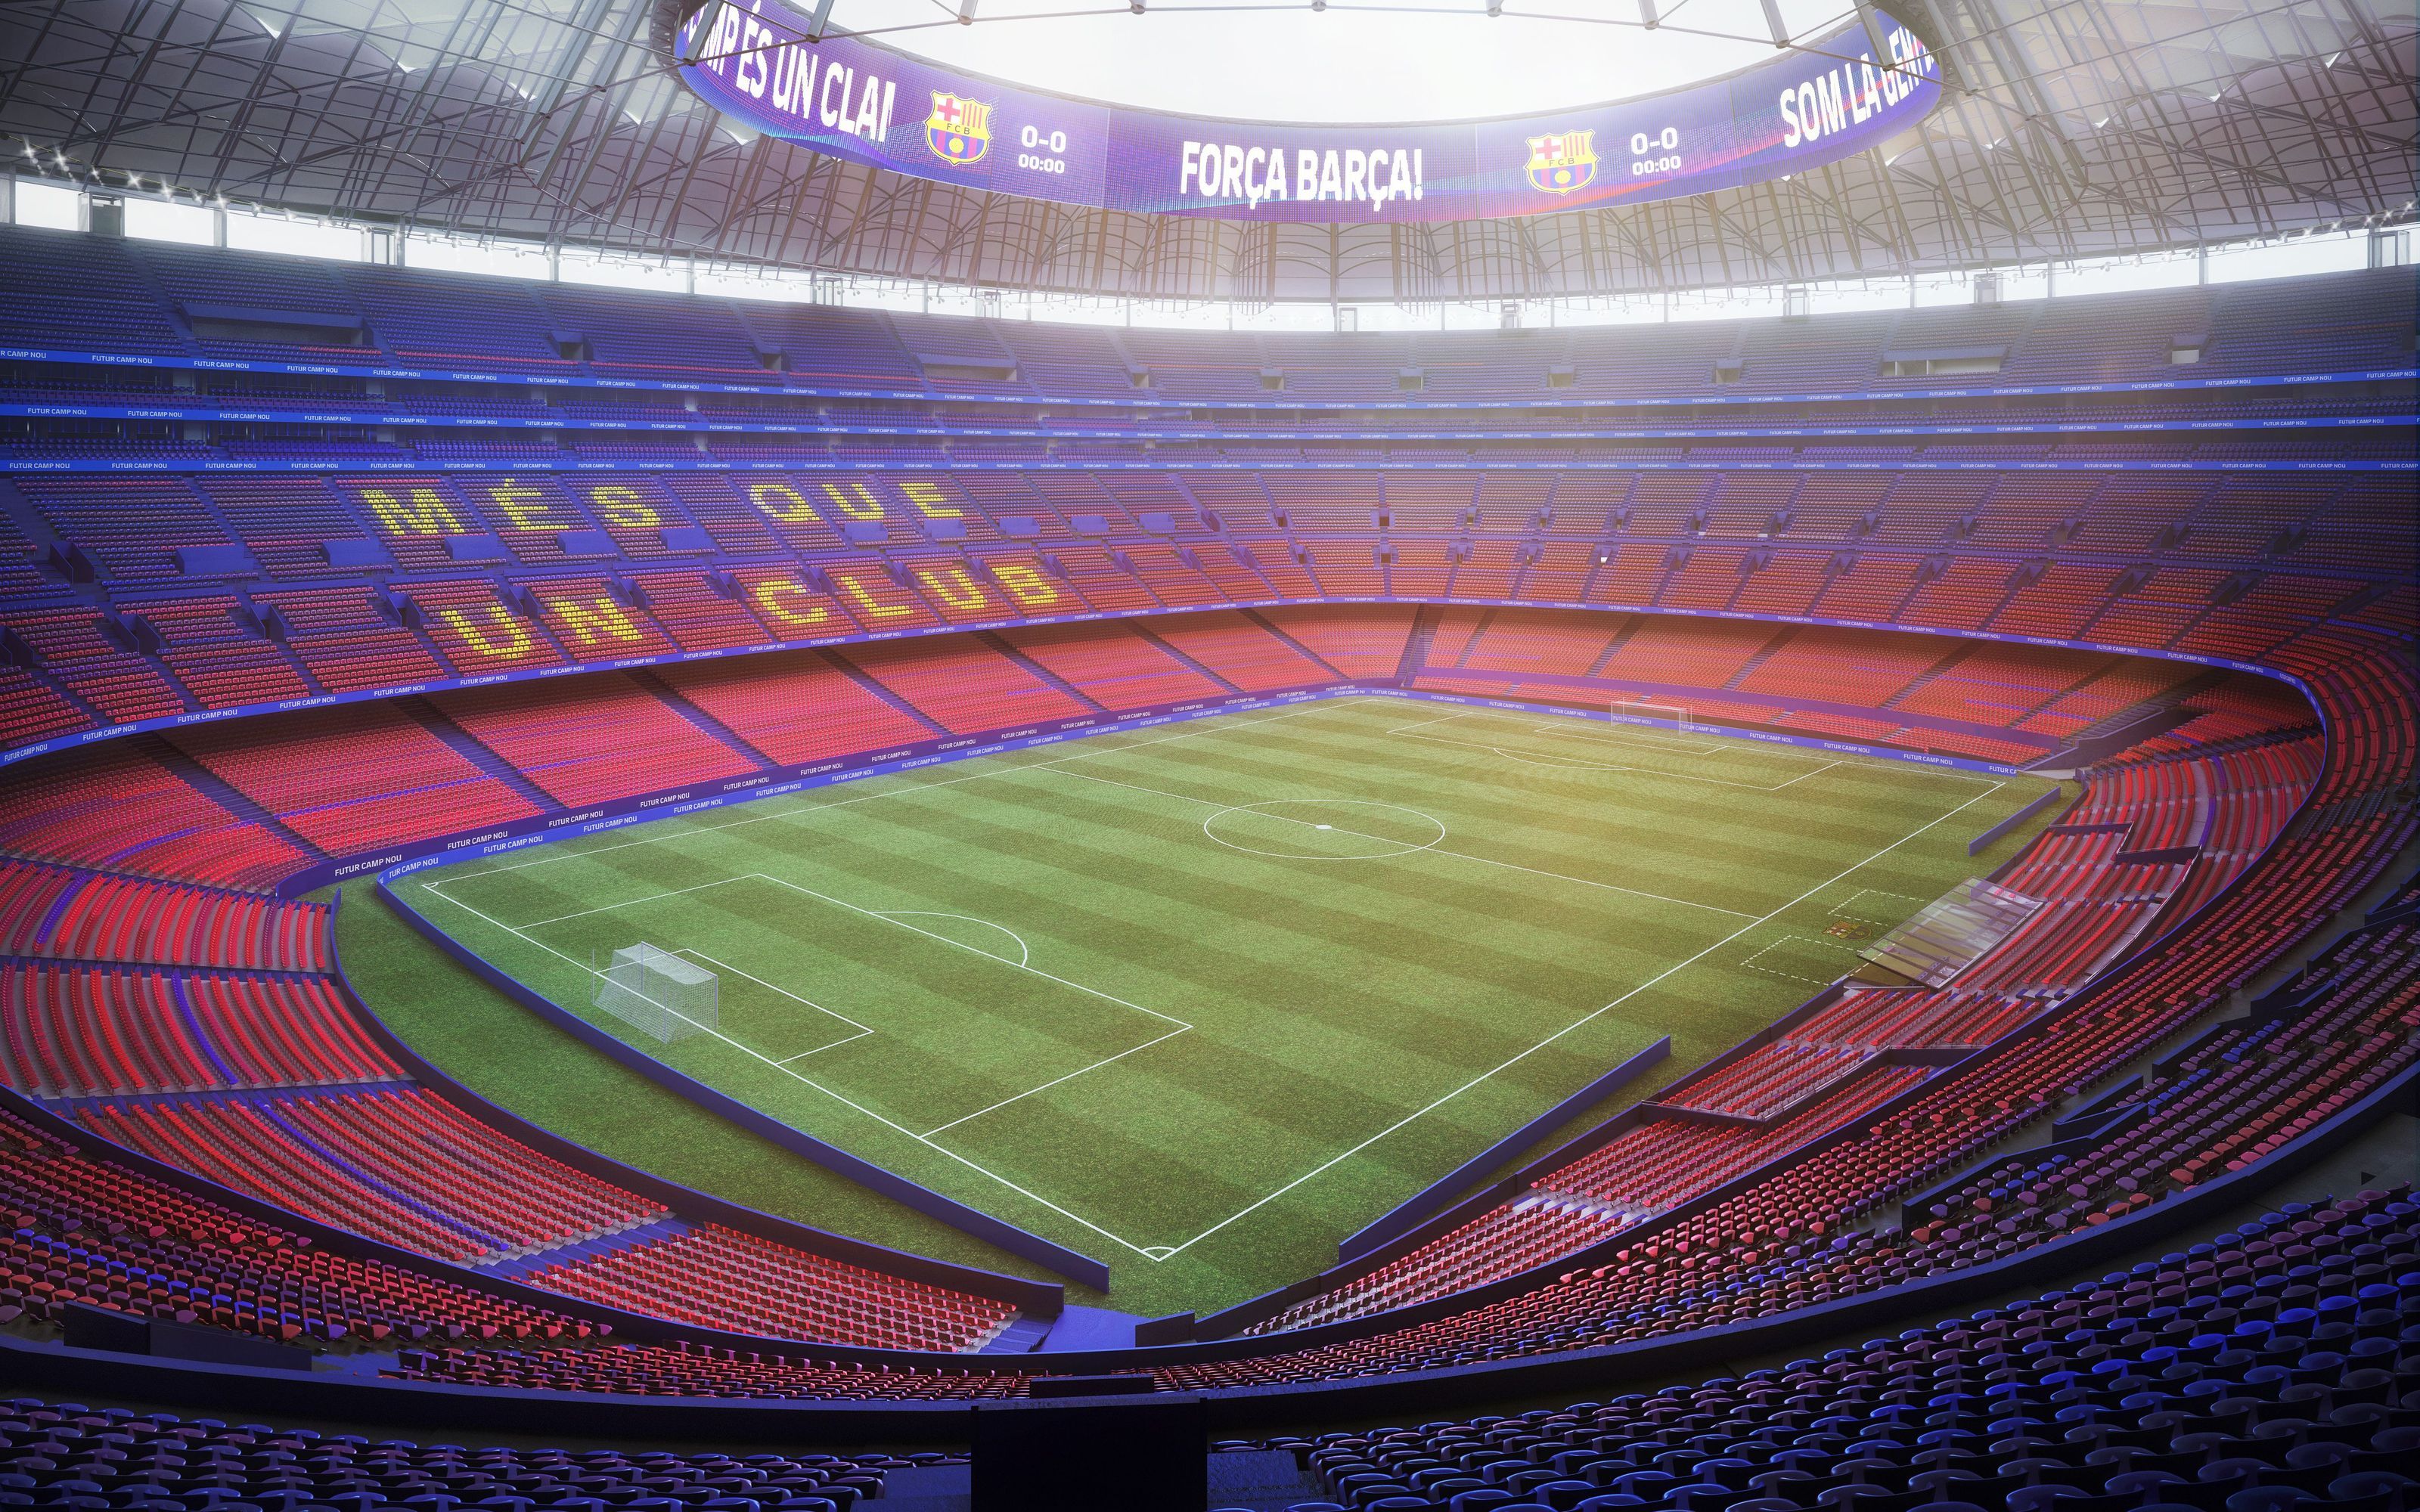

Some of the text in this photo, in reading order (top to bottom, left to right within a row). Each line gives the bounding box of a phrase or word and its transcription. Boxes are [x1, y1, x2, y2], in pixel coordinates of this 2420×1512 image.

[736, 2, 772, 98] ÉS
[773, 39, 818, 119] UN
[1780, 70, 1847, 147] SOM
[1845, 52, 1882, 125] LA
[946, 123, 970, 135] FCB
[1022, 125, 1066, 153] 0-0
[1630, 127, 1678, 155] 0-0
[1019, 153, 1065, 174] 00:00
[1549, 158, 1575, 166] FCB
[1632, 155, 1681, 175] 00:00
[1181, 141, 1423, 212] FORÇA BARÇA!
[360, 478, 963, 535] MÉS QUE
[440, 565, 1058, 659] UN CLUB
[460, 677, 479, 686] FUTUR
[374, 688, 394, 696] FUTUR
[394, 686, 412, 694] CAMP
[279, 696, 336, 709] FUTUR CAMP NOU
[177, 708, 238, 723] FUTUR CAMP NOU
[82, 724, 137, 742] FUTUR CAMP NOU
[5, 743, 48, 762] FUTUR CAMP NOU
[1824, 742, 1842, 750] FUTUR
[871, 754, 887, 762] FUTUR
[887, 751, 901, 760] CAMP
[901, 761, 917, 769] FUTUR
[917, 758, 931, 766] CAMP
[1903, 753, 1922, 761] FUTUR
[800, 767, 818, 776] FUTUR
[817, 764, 832, 773] CAMP
[832, 768, 874, 782] FUTUR CAMP NOU
[723, 776, 770, 791] FUTUR CAMP NOU
[756, 782, 802, 797] FUTUR CAMP NOU
[640, 792, 690, 808] FUTUR CAMP NOU
[673, 798, 723, 814] FUTUR CAMP NOU
[548, 810, 603, 828] FUTUR CAMP NOU
[583, 815, 638, 832] FUTUR CAMP NOU
[448, 830, 508, 850] FUTUR CAMP NOU
[483, 835, 544, 854] FUTUR CAMP NOU
[334, 854, 402, 877] FUTUR CAMP NOU
[402, 861, 422, 873] CAMP
[423, 857, 439, 867] NOU
